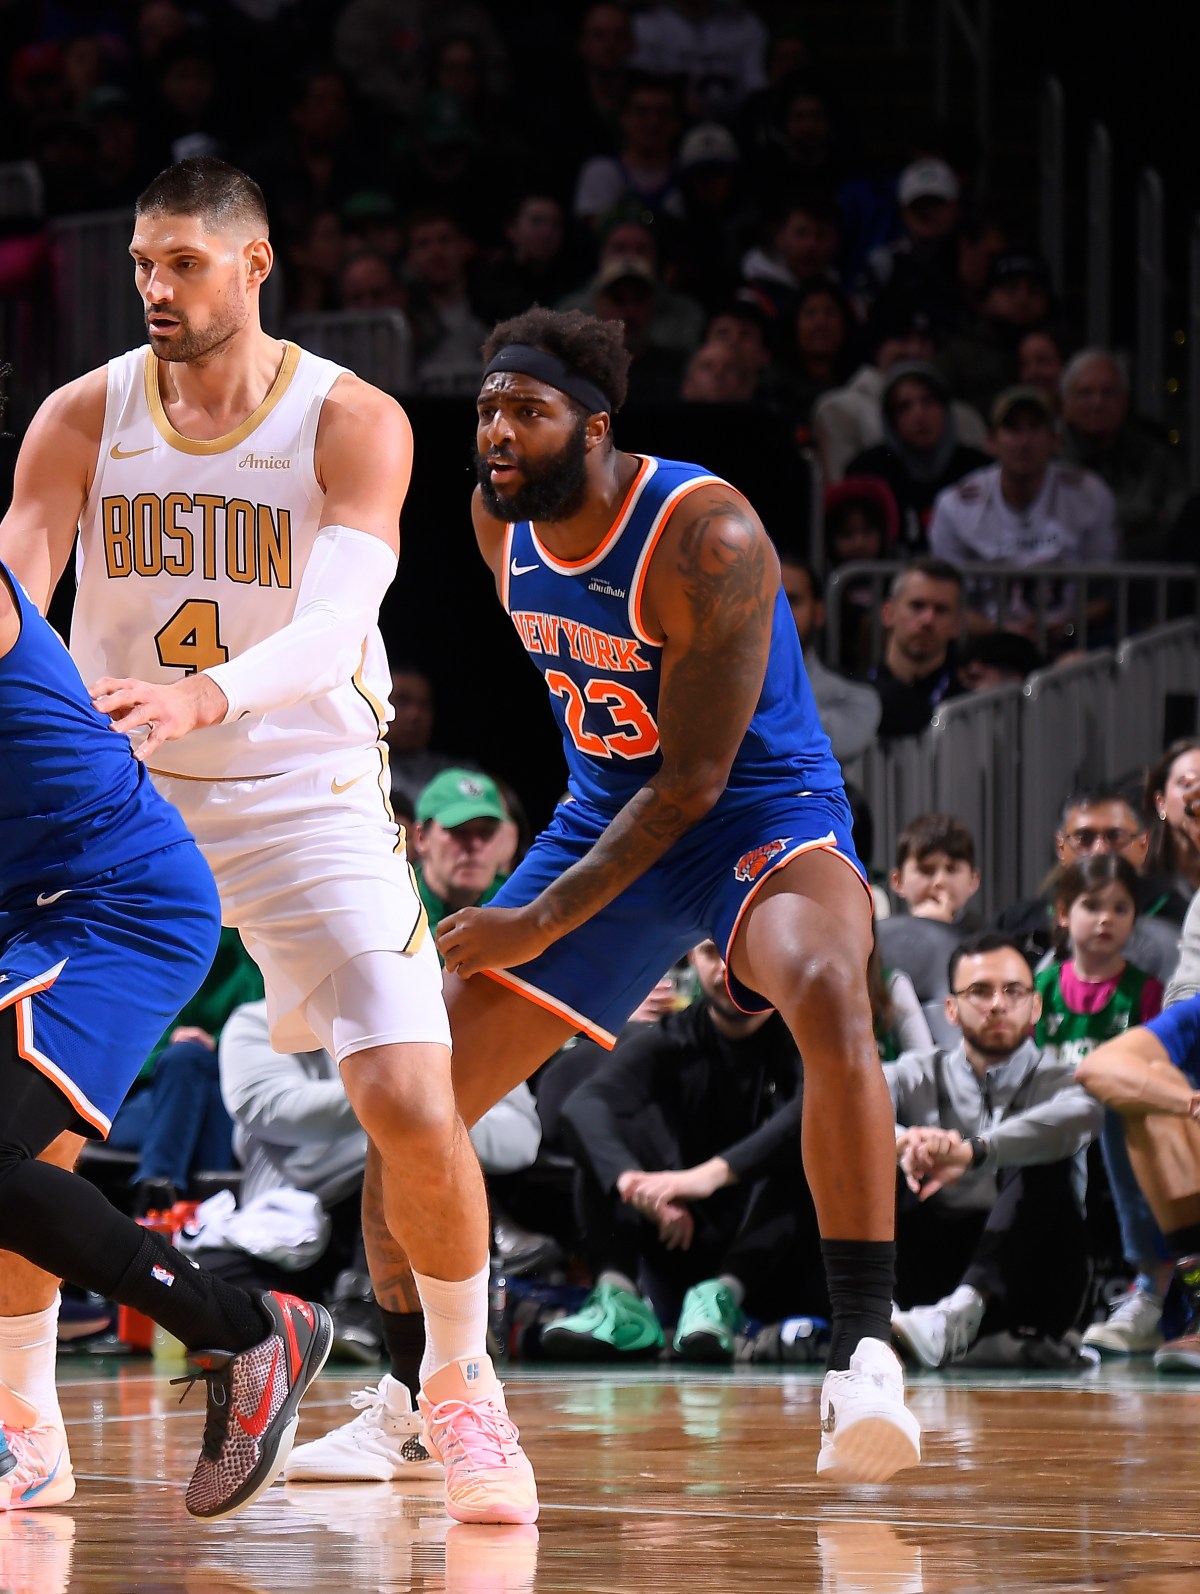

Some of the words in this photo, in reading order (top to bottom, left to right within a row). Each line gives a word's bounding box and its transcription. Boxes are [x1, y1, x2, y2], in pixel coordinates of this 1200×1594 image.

[238, 453, 291, 470] Amica
[102, 491, 292, 589] BOSTON
[153, 598, 230, 678] 4
[510, 610, 560, 657] NEW
[559, 616, 653, 672] YORK
[544, 668, 660, 761] 23
